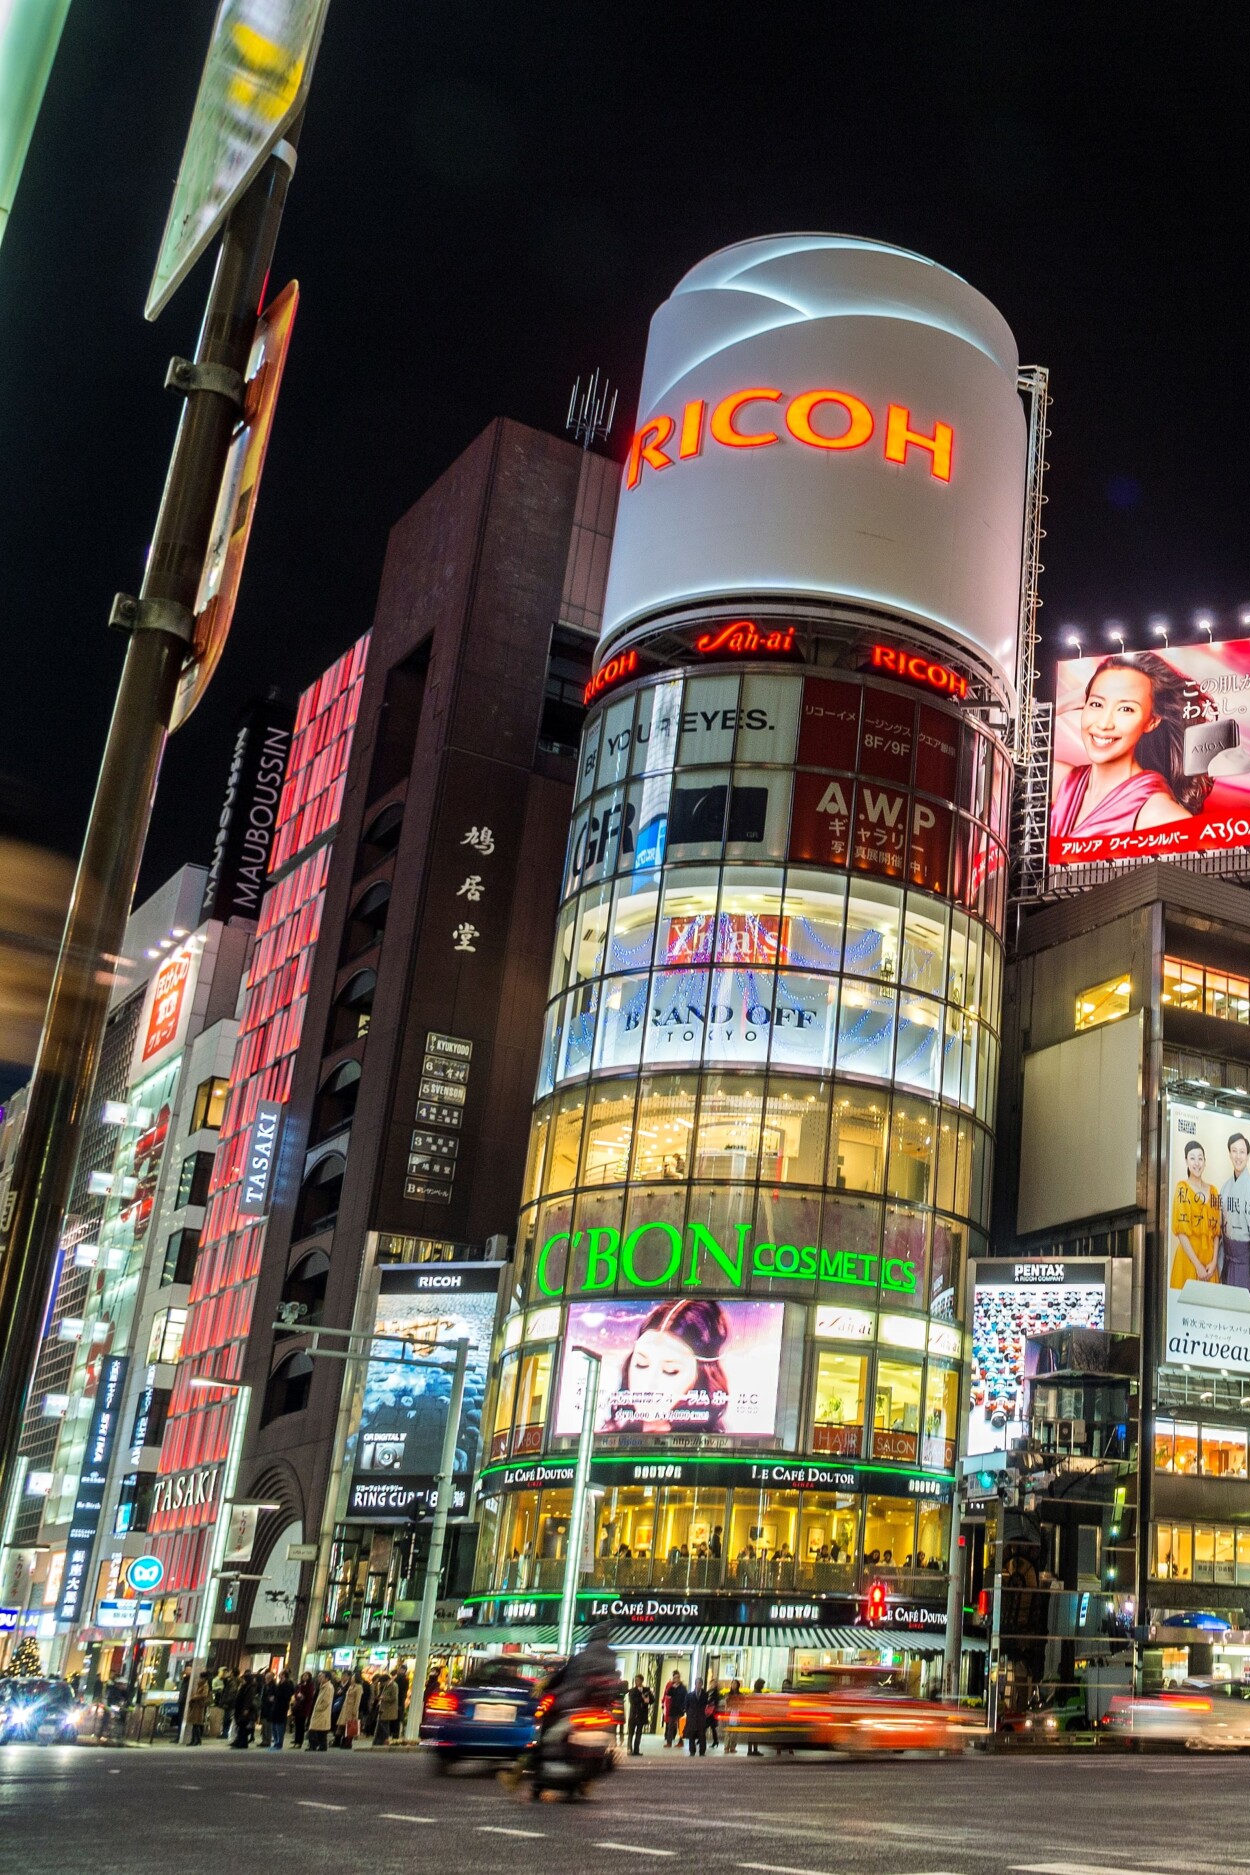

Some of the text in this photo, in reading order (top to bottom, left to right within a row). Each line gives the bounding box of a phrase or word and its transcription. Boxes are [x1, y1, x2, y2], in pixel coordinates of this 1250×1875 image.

[626, 387, 954, 490] RICOH
[698, 620, 795, 653] San-ai
[583, 651, 637, 706] RICOH
[872, 644, 969, 699] RICOH
[682, 708, 775, 733] EYES.
[864, 733, 911, 756] 8F/9F
[1191, 741, 1225, 754] ARSOA
[233, 726, 290, 909] MAUBOUSSIN
[572, 801, 637, 878] GR
[828, 818, 925, 853] ギャラリー
[1061, 831, 1189, 855] アルソア クイーンシルバー
[452, 825, 495, 953] 鳩居堂
[625, 1004, 818, 1032] BRAND OFF
[667, 1030, 758, 1044] TOKYO
[425, 1061, 433, 1071] 6
[422, 1084, 430, 1094] 5
[245, 1111, 278, 1204] TASAKI
[537, 1221, 917, 1297] C'BON COSMETICS
[1014, 1263, 1065, 1277] PENTAX
[418, 1275, 462, 1288] RICOH
[876, 1438, 915, 1455] SALON
[536, 1465, 574, 1480] DOUTOR
[634, 1464, 682, 1480] DOUTOR
[772, 1465, 805, 1482] CAFÉ
[808, 1467, 855, 1485] DOUTOR
[153, 1469, 218, 1514] TASAKI
[354, 1491, 386, 1507] RING
[592, 1600, 699, 1616] LE CAFÉ DOUTOR
[770, 1605, 819, 1620] DOUTOR
[895, 1607, 919, 1622] CAFÉ
